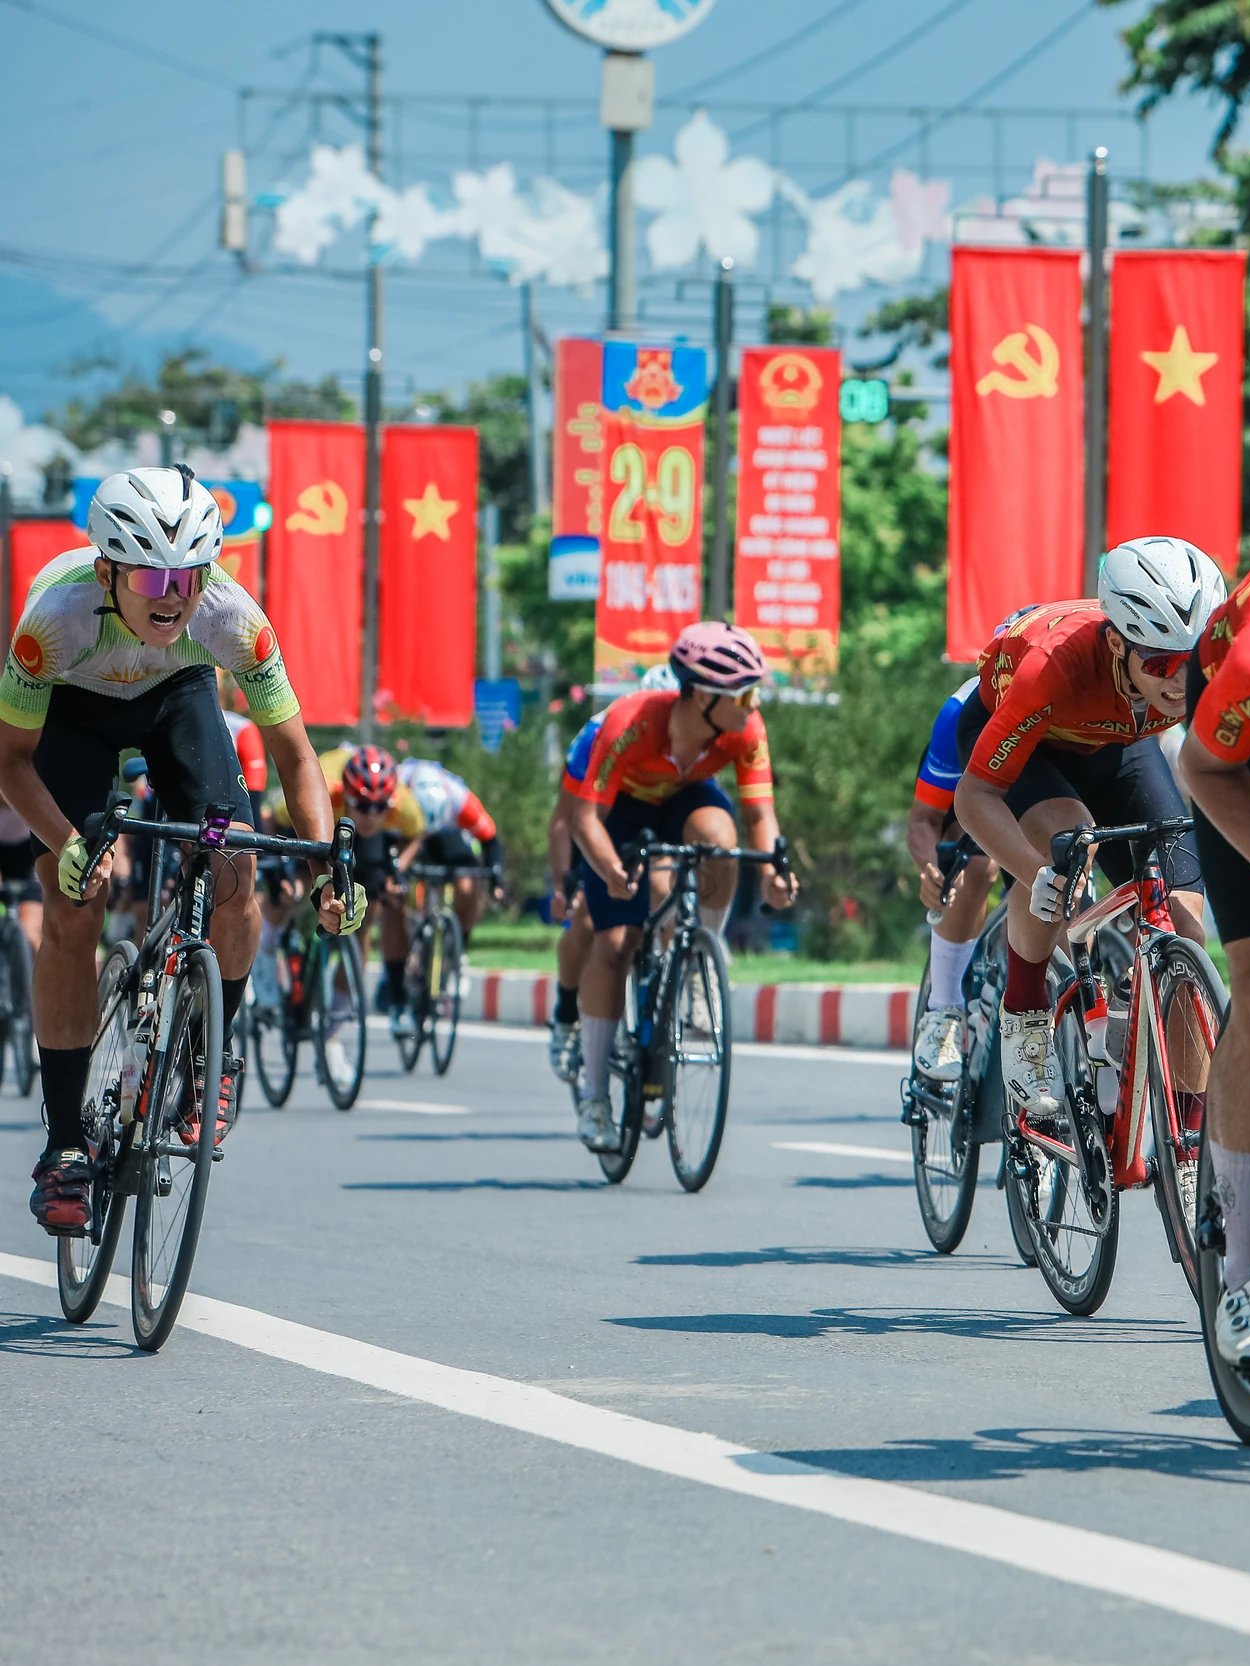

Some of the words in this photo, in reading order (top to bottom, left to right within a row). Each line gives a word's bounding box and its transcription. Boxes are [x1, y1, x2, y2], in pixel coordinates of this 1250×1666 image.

[608, 443, 694, 546] 2-9
[988, 733, 1021, 772] QUÂN
[1017, 713, 1042, 734] KHU
[1008, 1079, 1031, 1102] SIDI
[61, 1151, 88, 1165] SIDI
